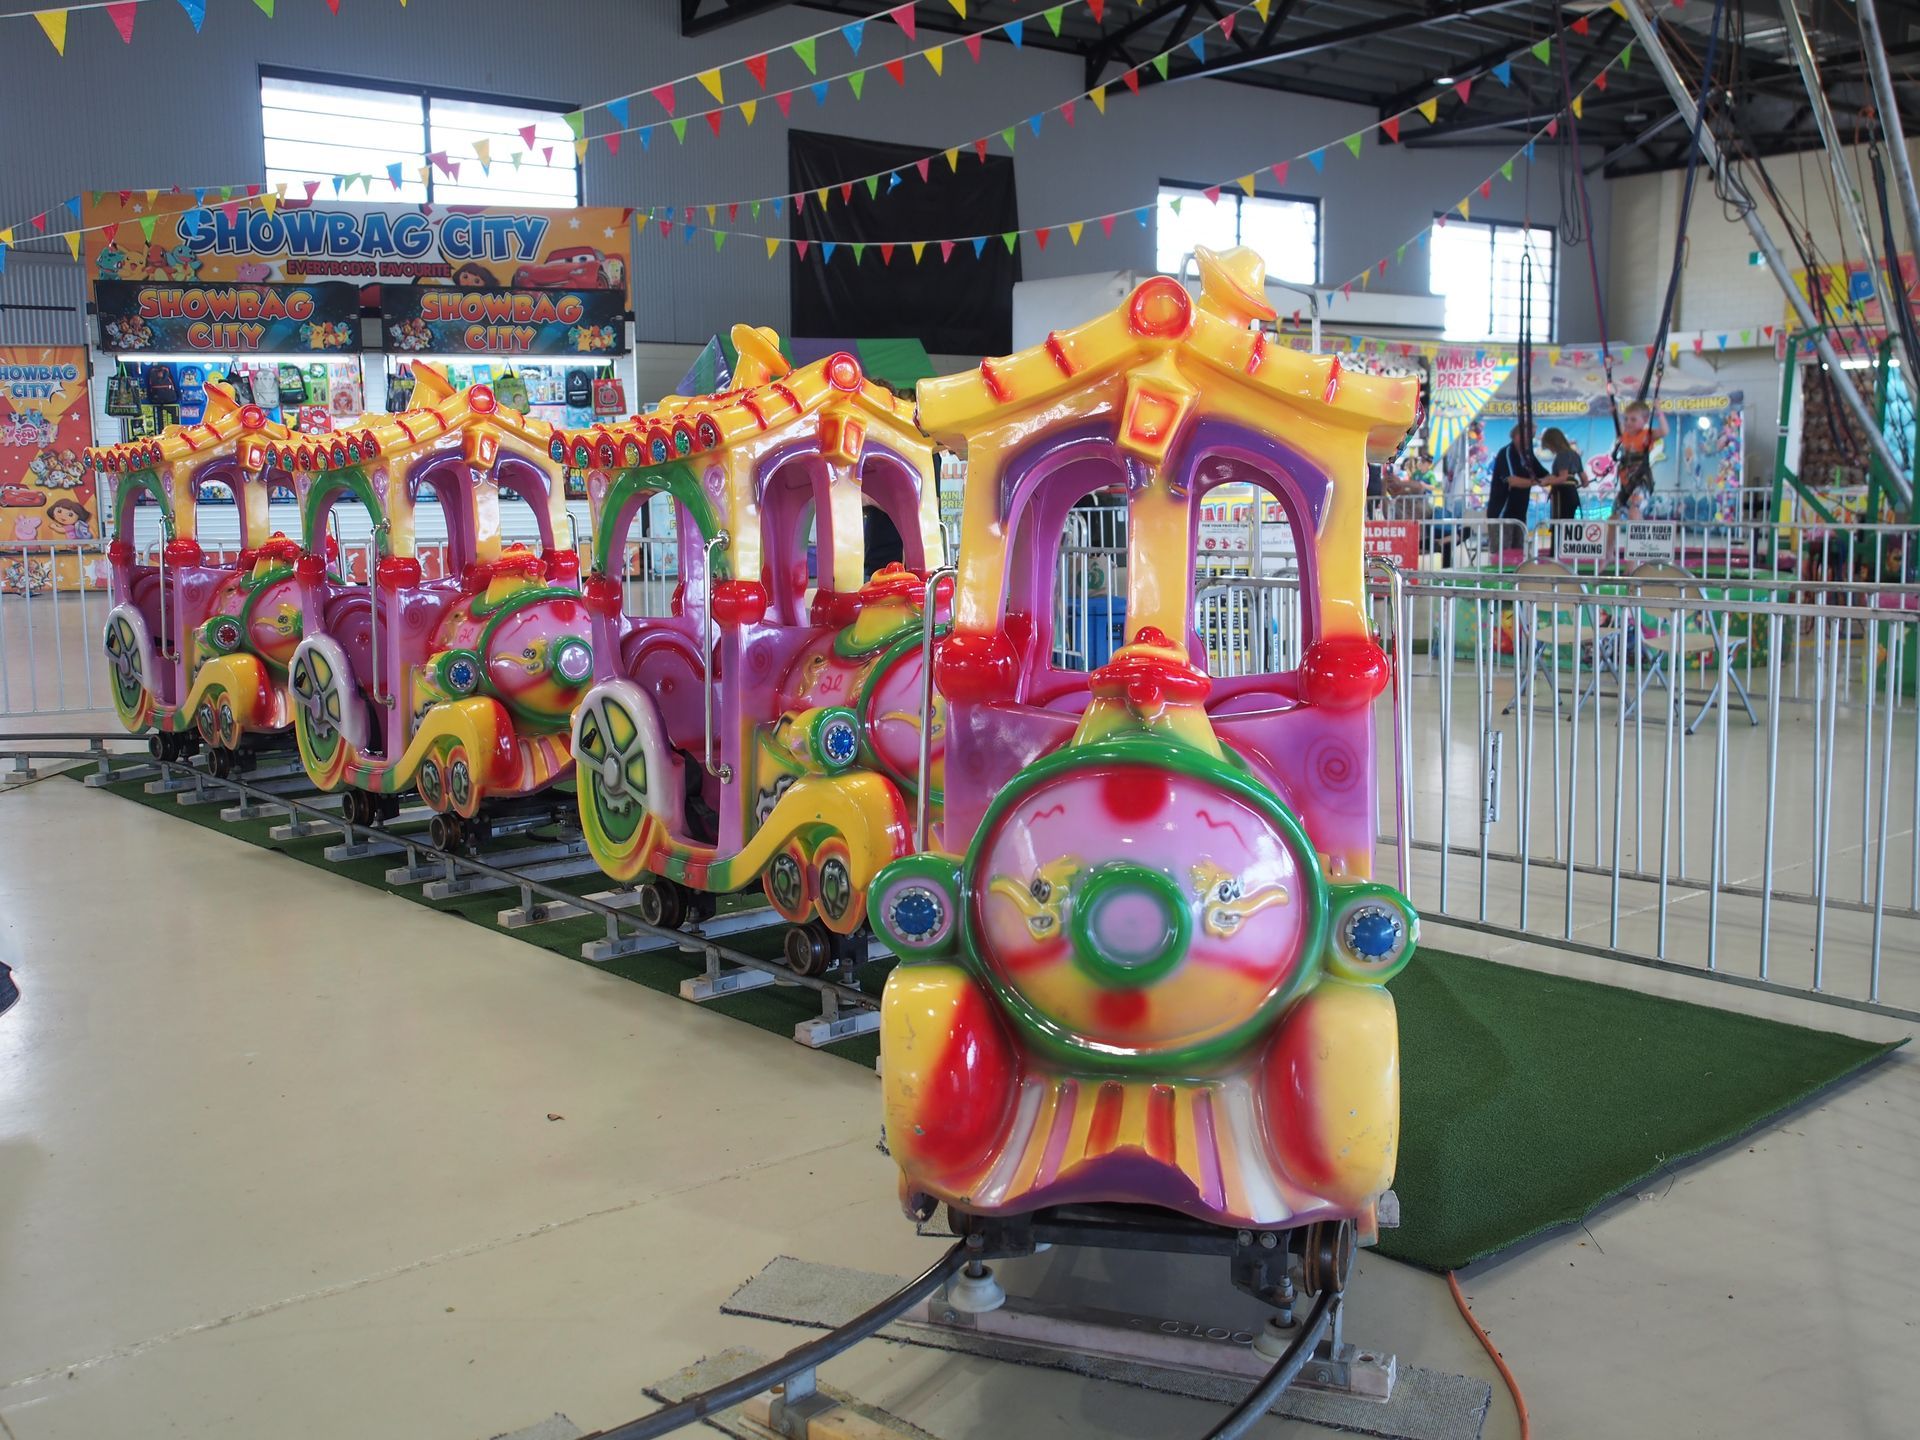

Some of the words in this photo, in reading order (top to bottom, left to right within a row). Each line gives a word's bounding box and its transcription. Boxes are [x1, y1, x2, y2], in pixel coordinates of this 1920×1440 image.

[183, 209, 432, 257] SHOWBAG
[441, 213, 549, 261] CITY
[287, 260, 378, 277] EVERYBODYS
[379, 262, 452, 277] FAVOURITE
[138, 289, 314, 321] SHOWBAG
[421, 293, 583, 324] SHOWBAG
[187, 323, 265, 351] CITY
[463, 325, 537, 352] CITY
[0, 364, 78, 381] HOWBAG
[1436, 371, 1493, 388] PRIZES
[11, 383, 54, 399] CITY
[1536, 401, 1588, 413] FISHING
[941, 491, 959, 500] WIN
[941, 500, 963, 509] PRIZ
[1365, 527, 1406, 537] ILDREN
[1564, 524, 1583, 541] NO
[1630, 525, 1650, 533] EVERY
[1652, 525, 1672, 534] RIDER
[1653, 533, 1672, 541] TICKET
[1377, 541, 1392, 552] BE
[1563, 543, 1602, 554] SMOKING
